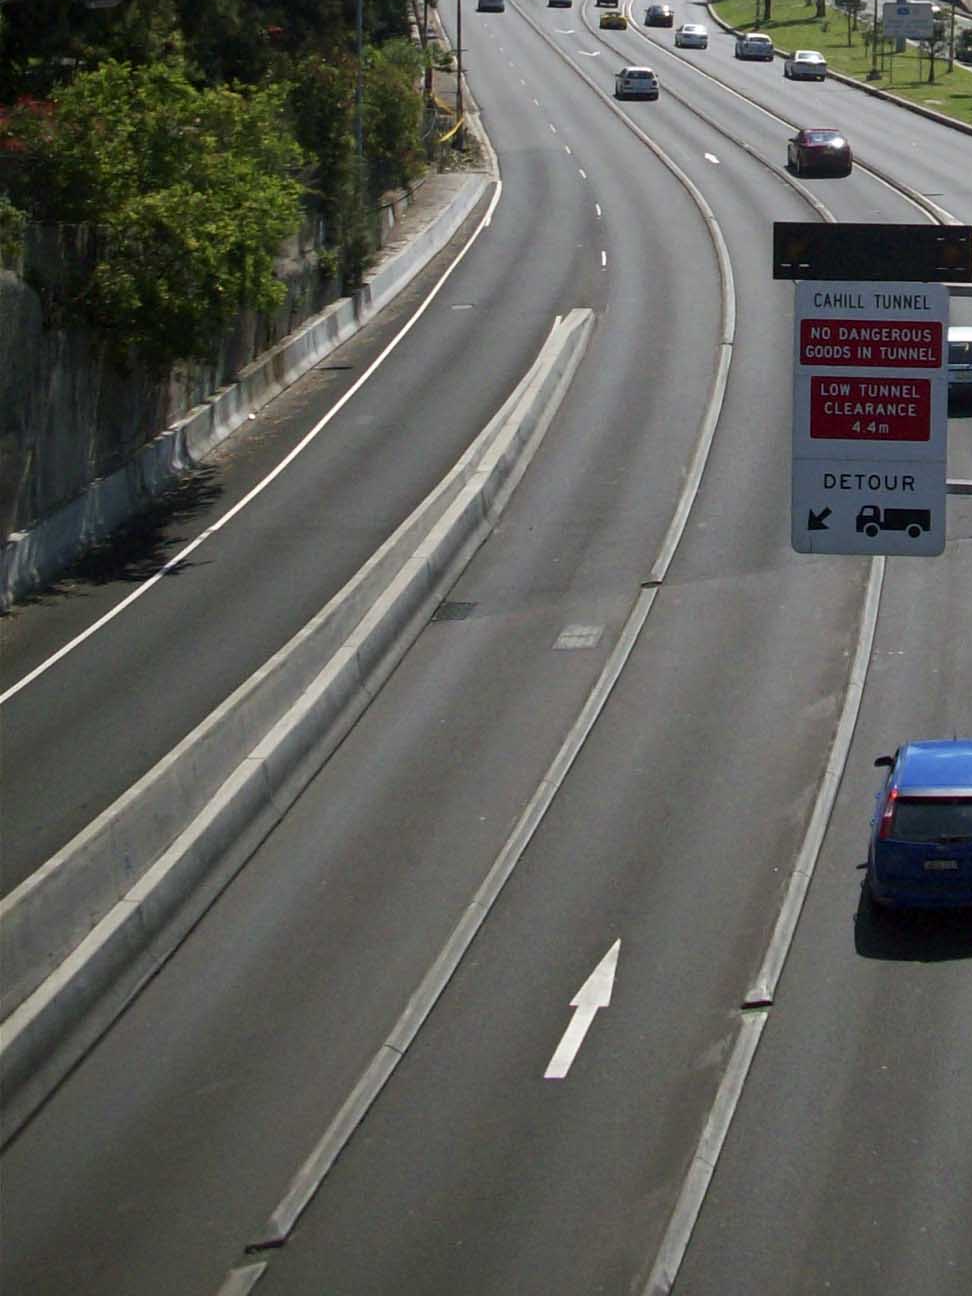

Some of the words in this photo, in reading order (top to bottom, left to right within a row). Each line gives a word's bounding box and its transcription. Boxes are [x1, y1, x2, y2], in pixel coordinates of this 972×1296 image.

[813, 292, 864, 310] CAHILL
[873, 294, 932, 311] TUNNEL
[810, 327, 832, 341] NO
[838, 327, 932, 343] DANGEROUS
[805, 345, 851, 360] GOODS
[857, 346, 873, 360] IN
[879, 347, 937, 362] TUNNEL
[820, 383, 850, 397] LOW
[858, 384, 921, 399] TUNNEL
[824, 401, 918, 417] CLEARANCE
[850, 420, 890, 435] 4.4m
[823, 473, 916, 492] DETOUR
